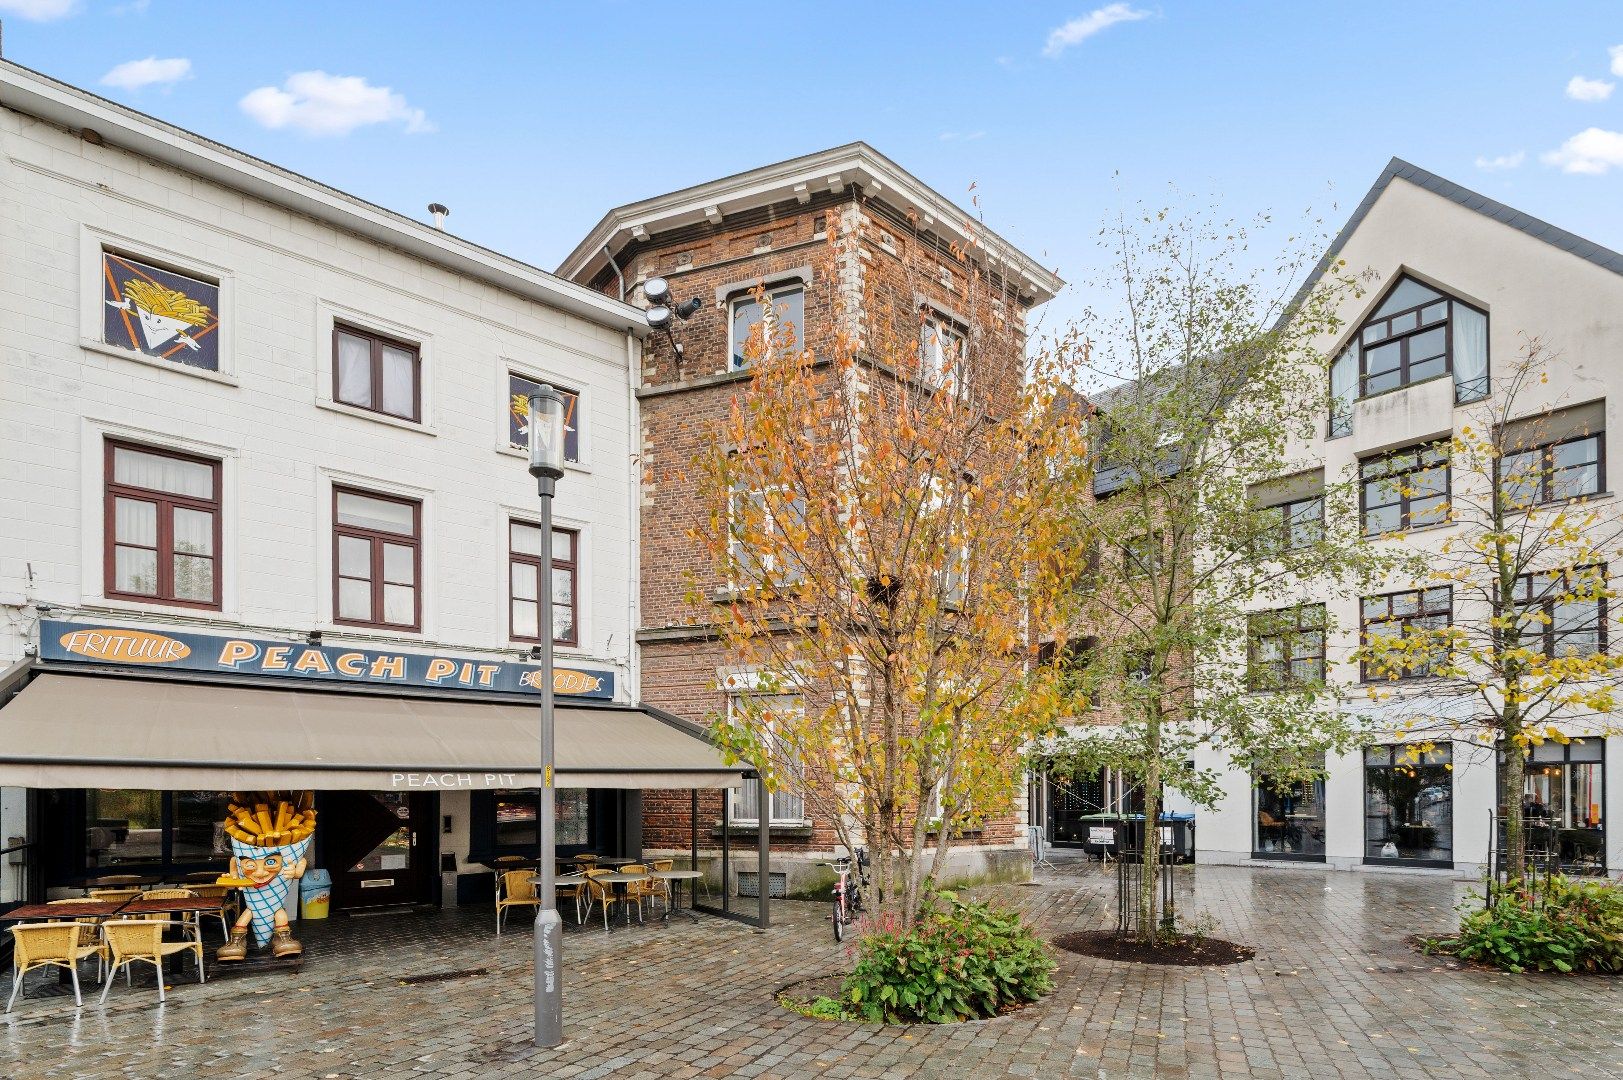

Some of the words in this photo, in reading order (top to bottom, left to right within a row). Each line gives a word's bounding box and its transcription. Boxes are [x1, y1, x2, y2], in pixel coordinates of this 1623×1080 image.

[66, 632, 187, 659] FRITUUR
[217, 640, 408, 680] PEACH
[425, 659, 501, 687] PIT
[519, 671, 605, 692] BRODJES
[392, 773, 472, 787] PEACH
[484, 773, 516, 786] PIT
